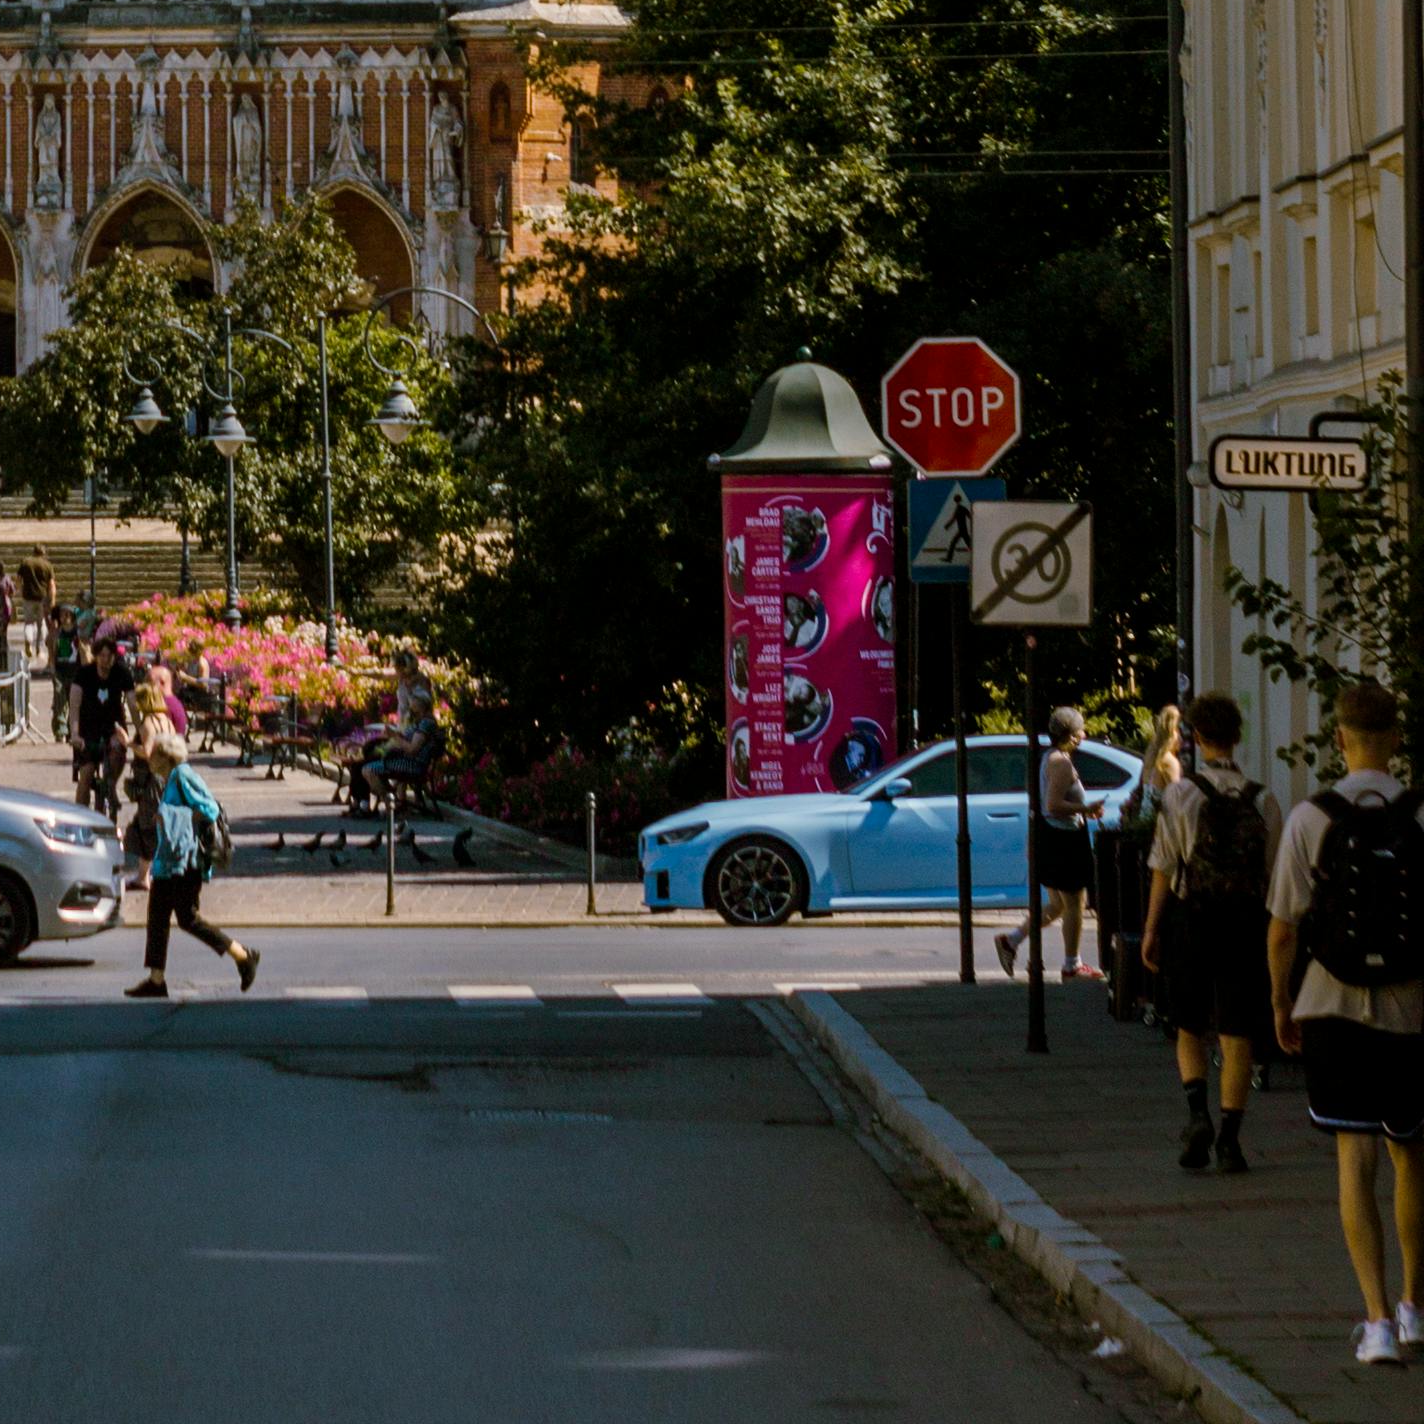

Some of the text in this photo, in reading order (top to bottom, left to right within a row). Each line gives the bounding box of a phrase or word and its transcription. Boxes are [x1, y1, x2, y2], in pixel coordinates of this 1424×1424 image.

[899, 387, 1005, 428] STOP
[755, 557, 780, 566] JAMES
[751, 566, 780, 576] CARTER
[744, 596, 781, 605] CHRISTIAN
[763, 615, 781, 625] TRIO
[757, 654, 781, 664] JAMES
[752, 692, 782, 702] WRIGHT
[754, 722, 782, 732] STACEY
[763, 732, 782, 742] KENT
[750, 770, 783, 780] KENNEDY
